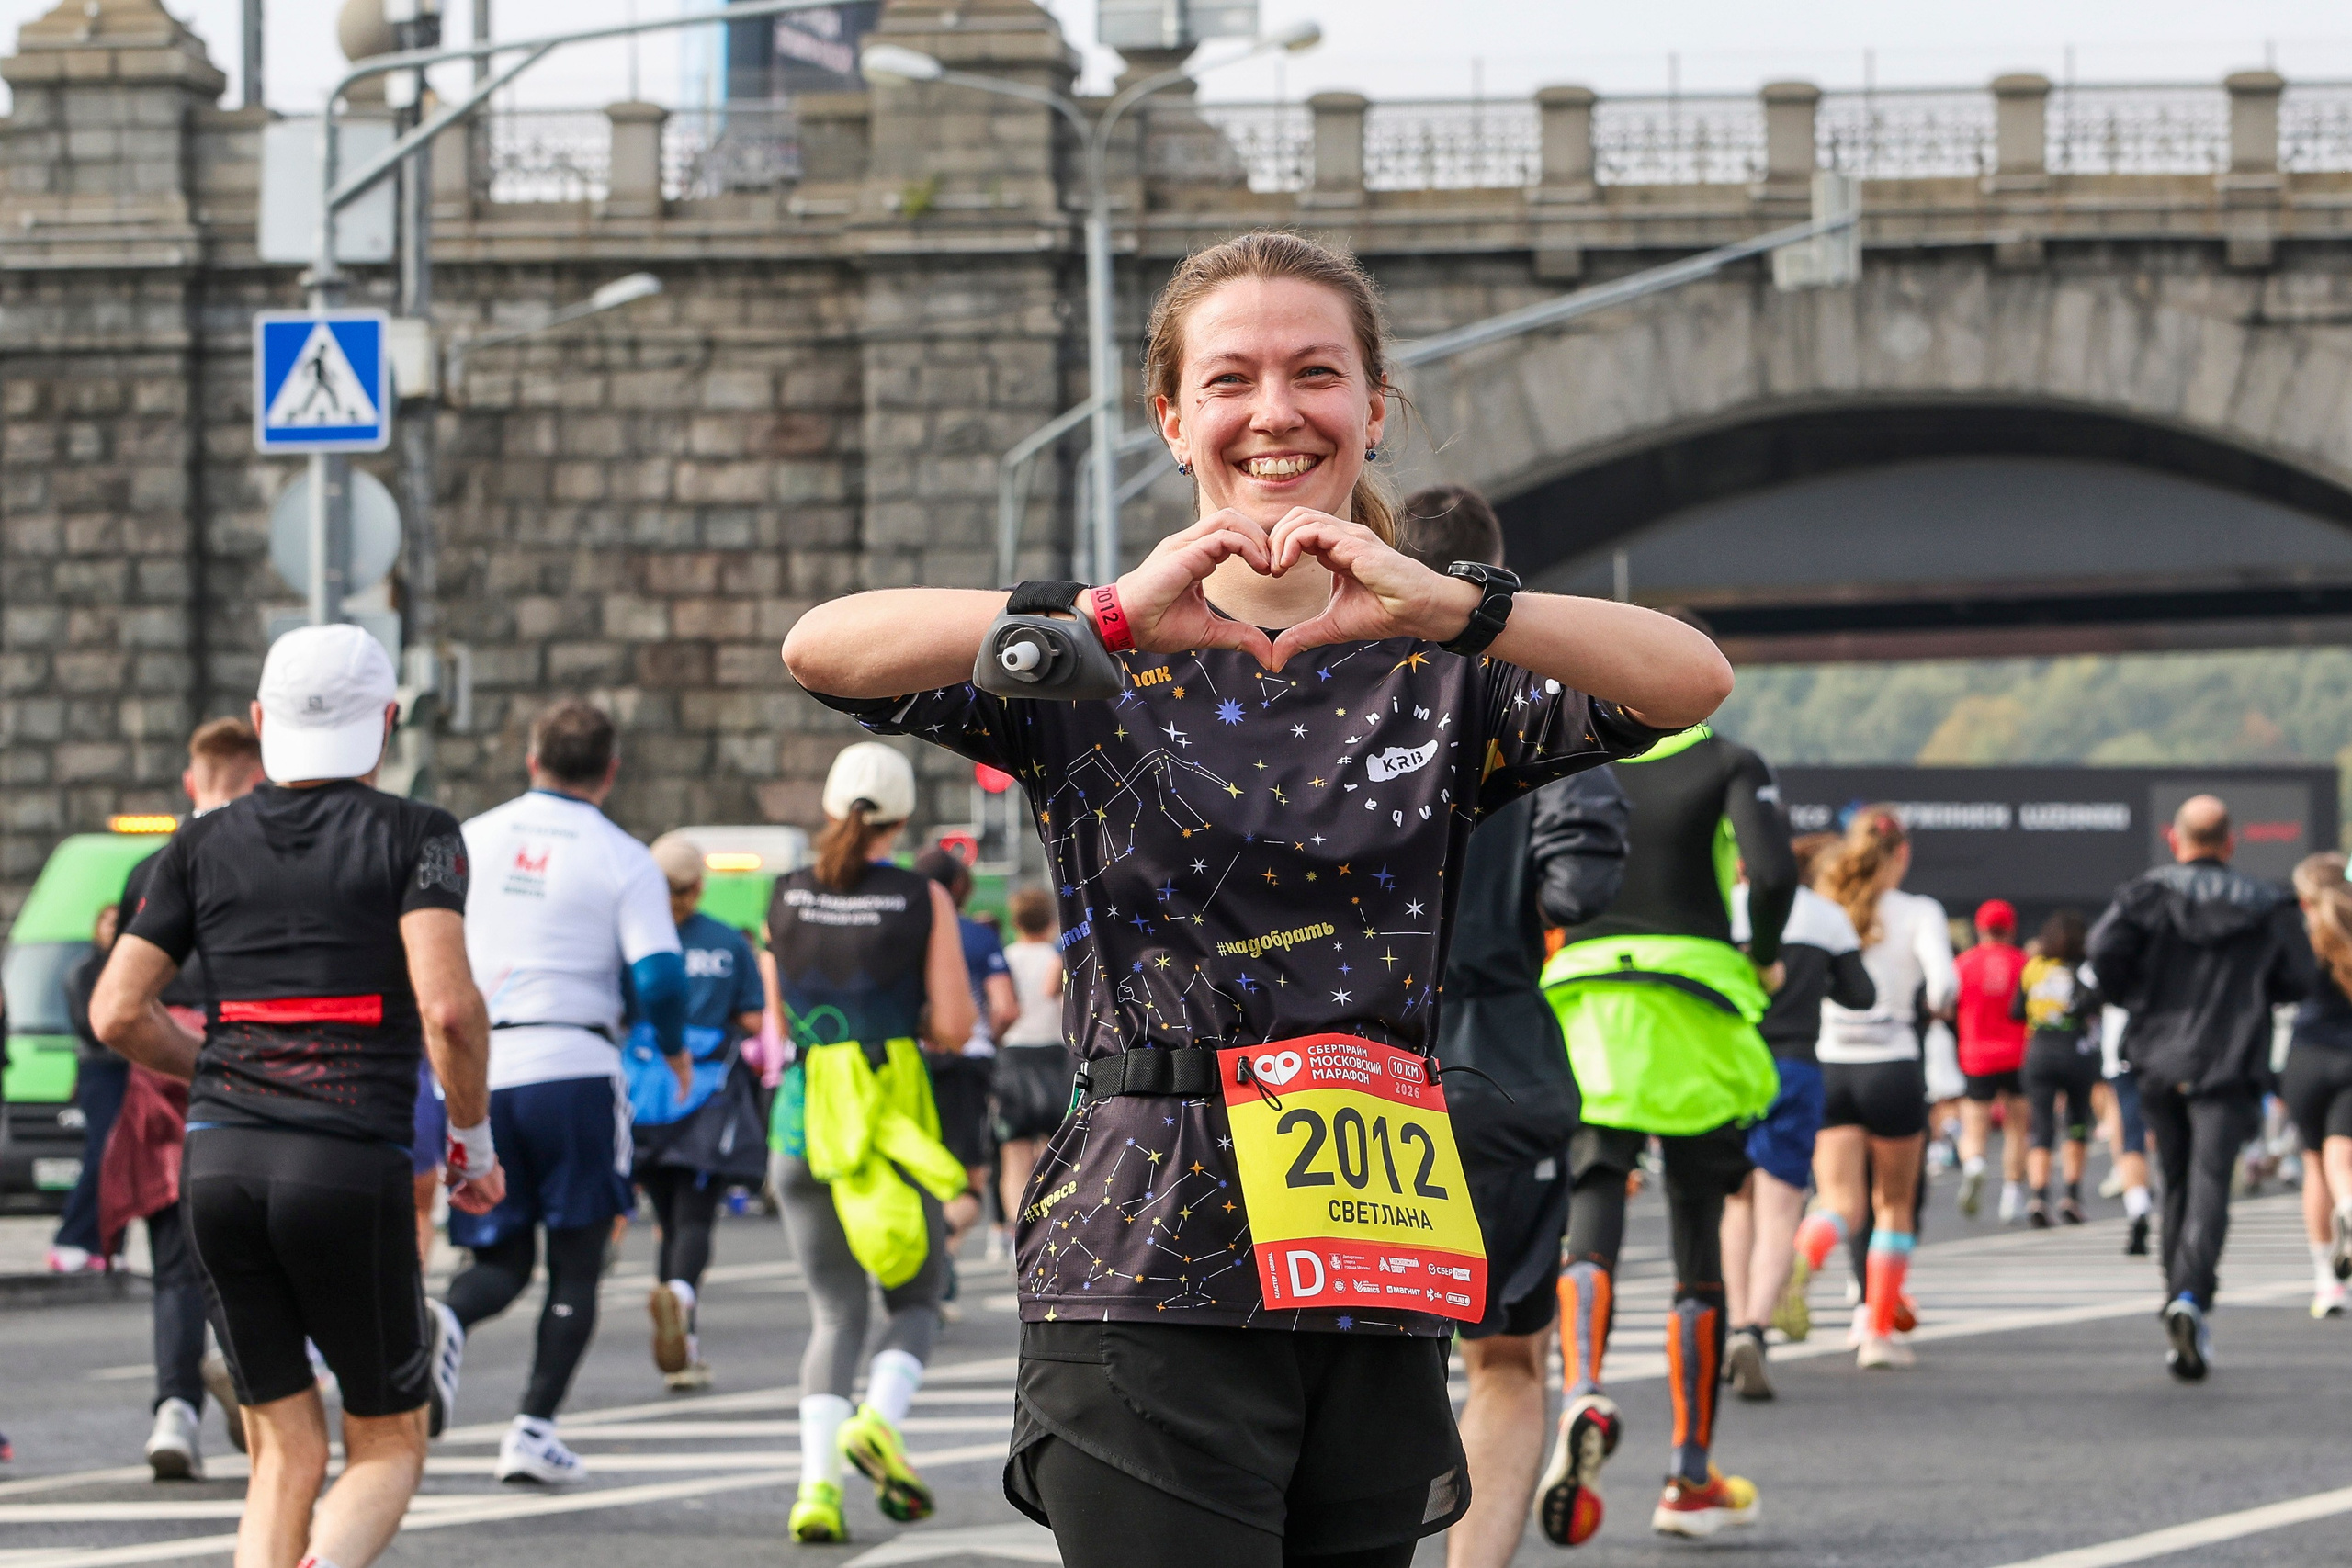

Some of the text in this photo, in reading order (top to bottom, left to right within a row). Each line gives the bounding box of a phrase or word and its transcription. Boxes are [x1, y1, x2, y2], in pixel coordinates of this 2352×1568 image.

[1096, 588, 1119, 625] 2012
[1117, 637, 1131, 647] 10
[1382, 750, 1424, 773] KRB
[1216, 921, 1335, 958] #надобрать
[1307, 1044, 1368, 1058] СБЕРПРАЙМ
[1309, 1055, 1382, 1076] МОСКОВСКИЙ
[1312, 1068, 1370, 1085] МАРАФОН
[1392, 1061, 1419, 1078] 10 КМ
[1395, 1082, 1420, 1099] 2026
[1276, 1107, 1449, 1201] 2012
[1023, 1180, 1077, 1224] #гдевсе
[1329, 1199, 1434, 1231] СВЕТЛАНА
[1286, 1249, 1326, 1297] D
